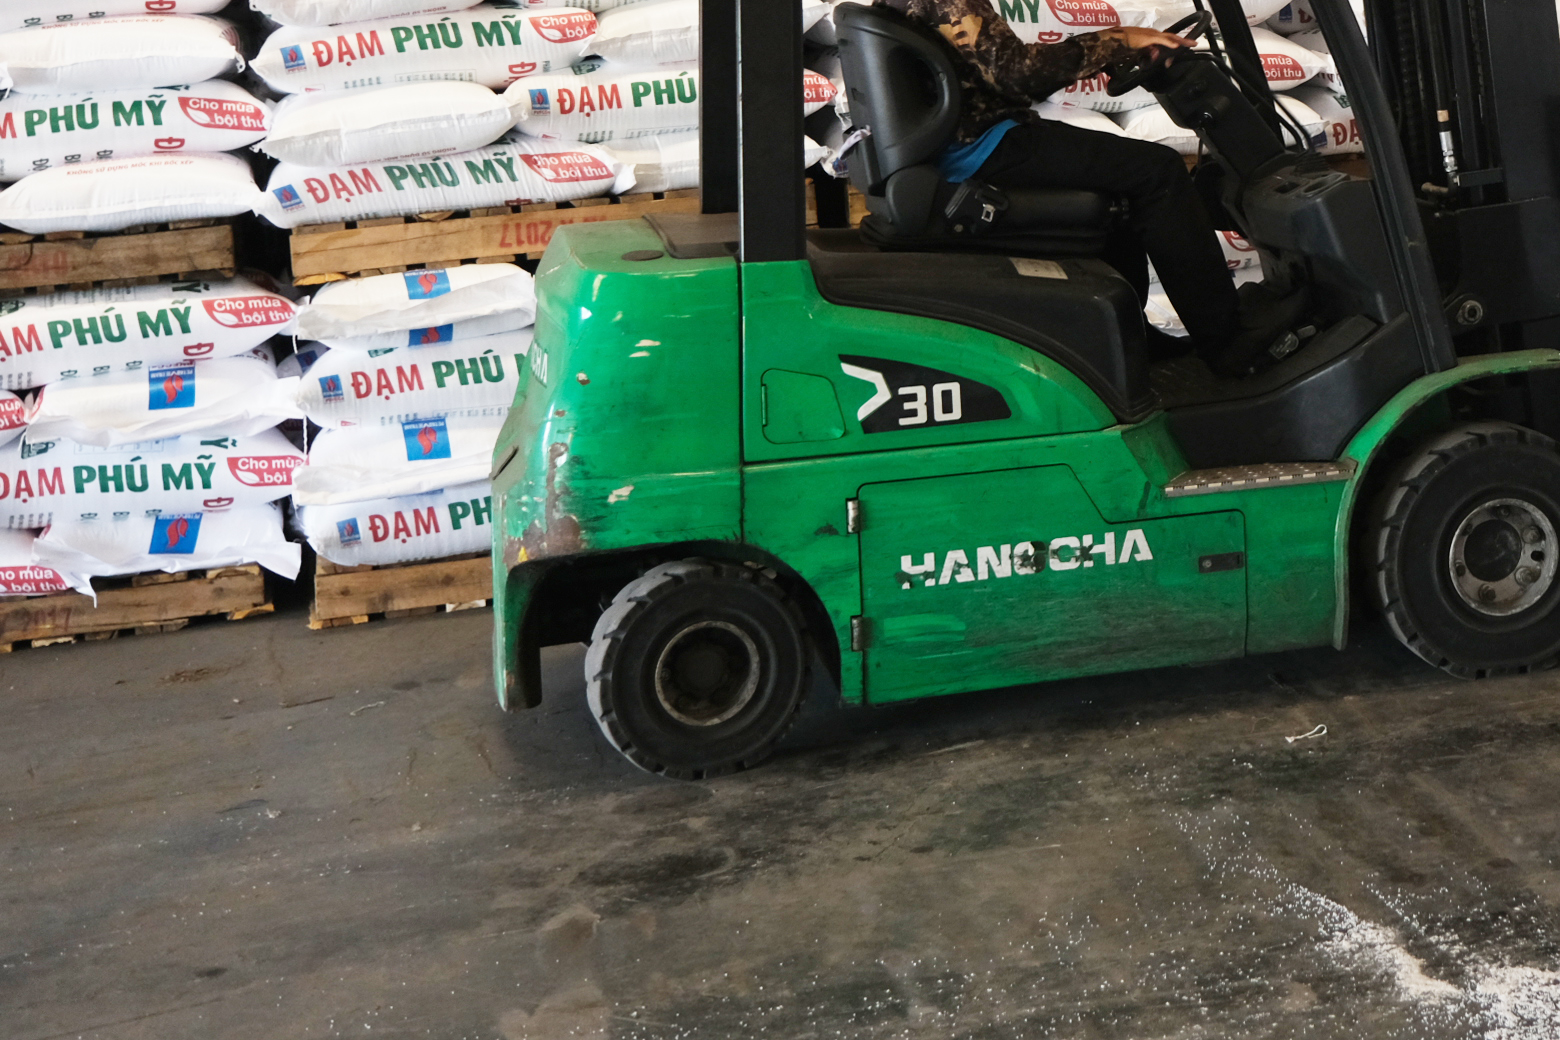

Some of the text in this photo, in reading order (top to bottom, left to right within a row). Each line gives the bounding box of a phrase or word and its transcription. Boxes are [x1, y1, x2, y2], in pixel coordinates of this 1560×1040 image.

[1055, 0, 1080, 10] Cho
[1077, 13, 1117, 23] bội thu
[312, 15, 522, 67] ĐẠM PHÚ MỸ
[556, 72, 697, 117] ĐẠM PHÚ
[189, 99, 219, 111] Cho
[25, 95, 167, 137] PHÚ MỸ
[214, 114, 239, 127] bội
[214, 297, 281, 311] Cho mùa
[48, 300, 192, 349] PHÚ MỸ
[242, 312, 267, 325] bội
[898, 382, 962, 426] 30
